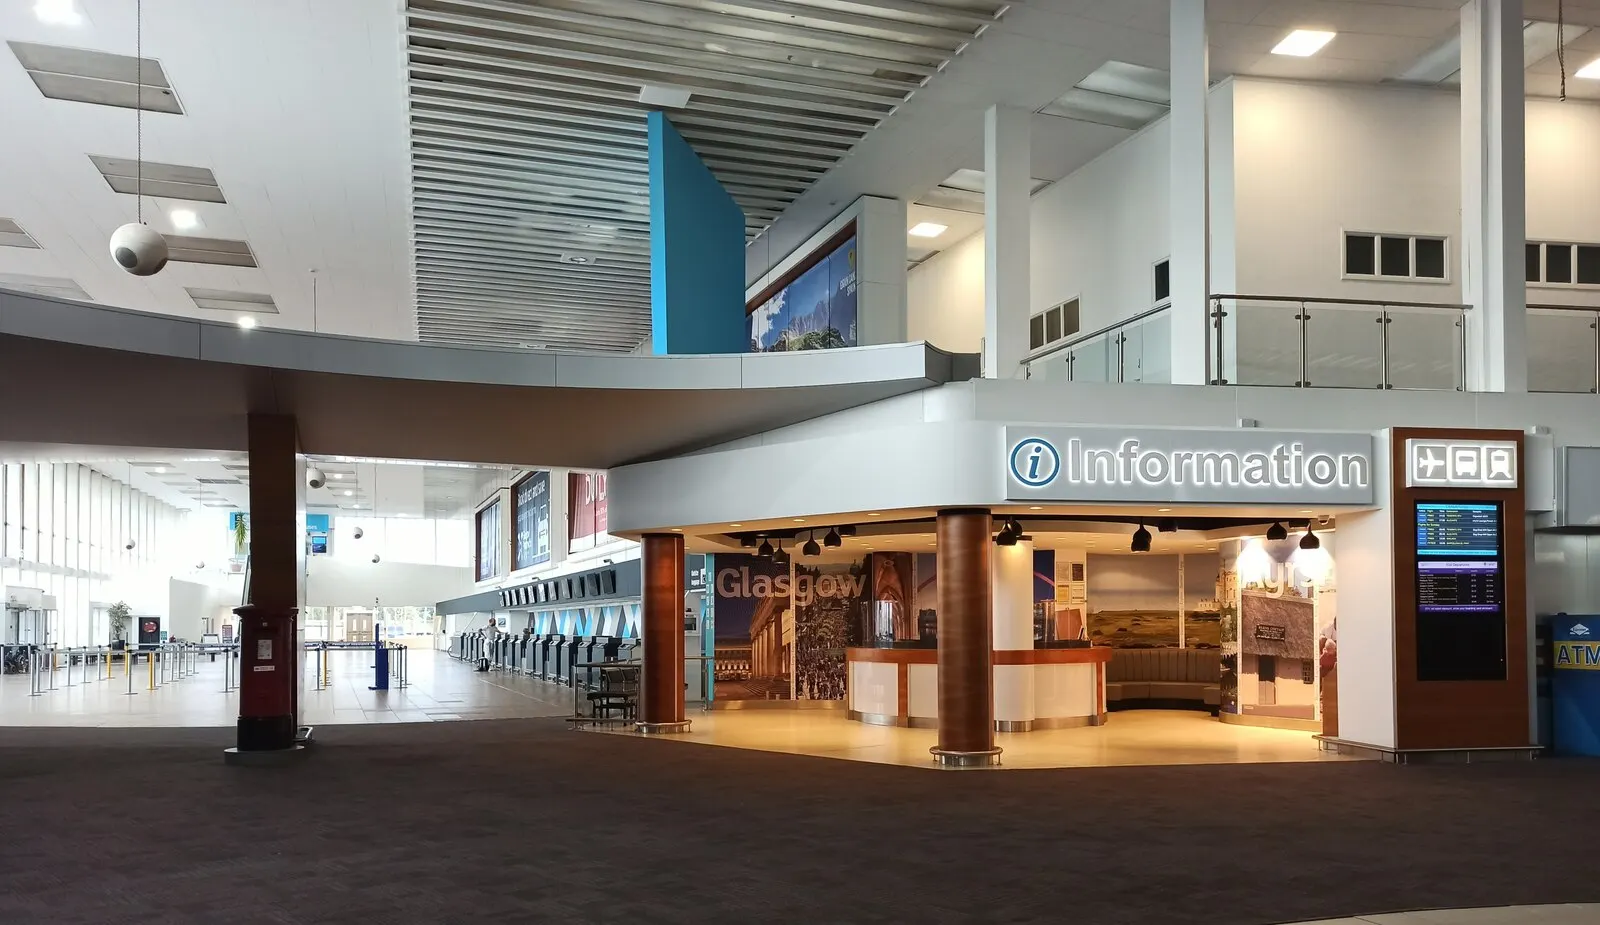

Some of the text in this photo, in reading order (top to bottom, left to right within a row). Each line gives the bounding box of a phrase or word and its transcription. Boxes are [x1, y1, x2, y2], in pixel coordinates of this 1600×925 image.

[1069, 438, 1369, 488] Information
[716, 566, 867, 607] Glasgow
[1556, 643, 1600, 666] ATM
